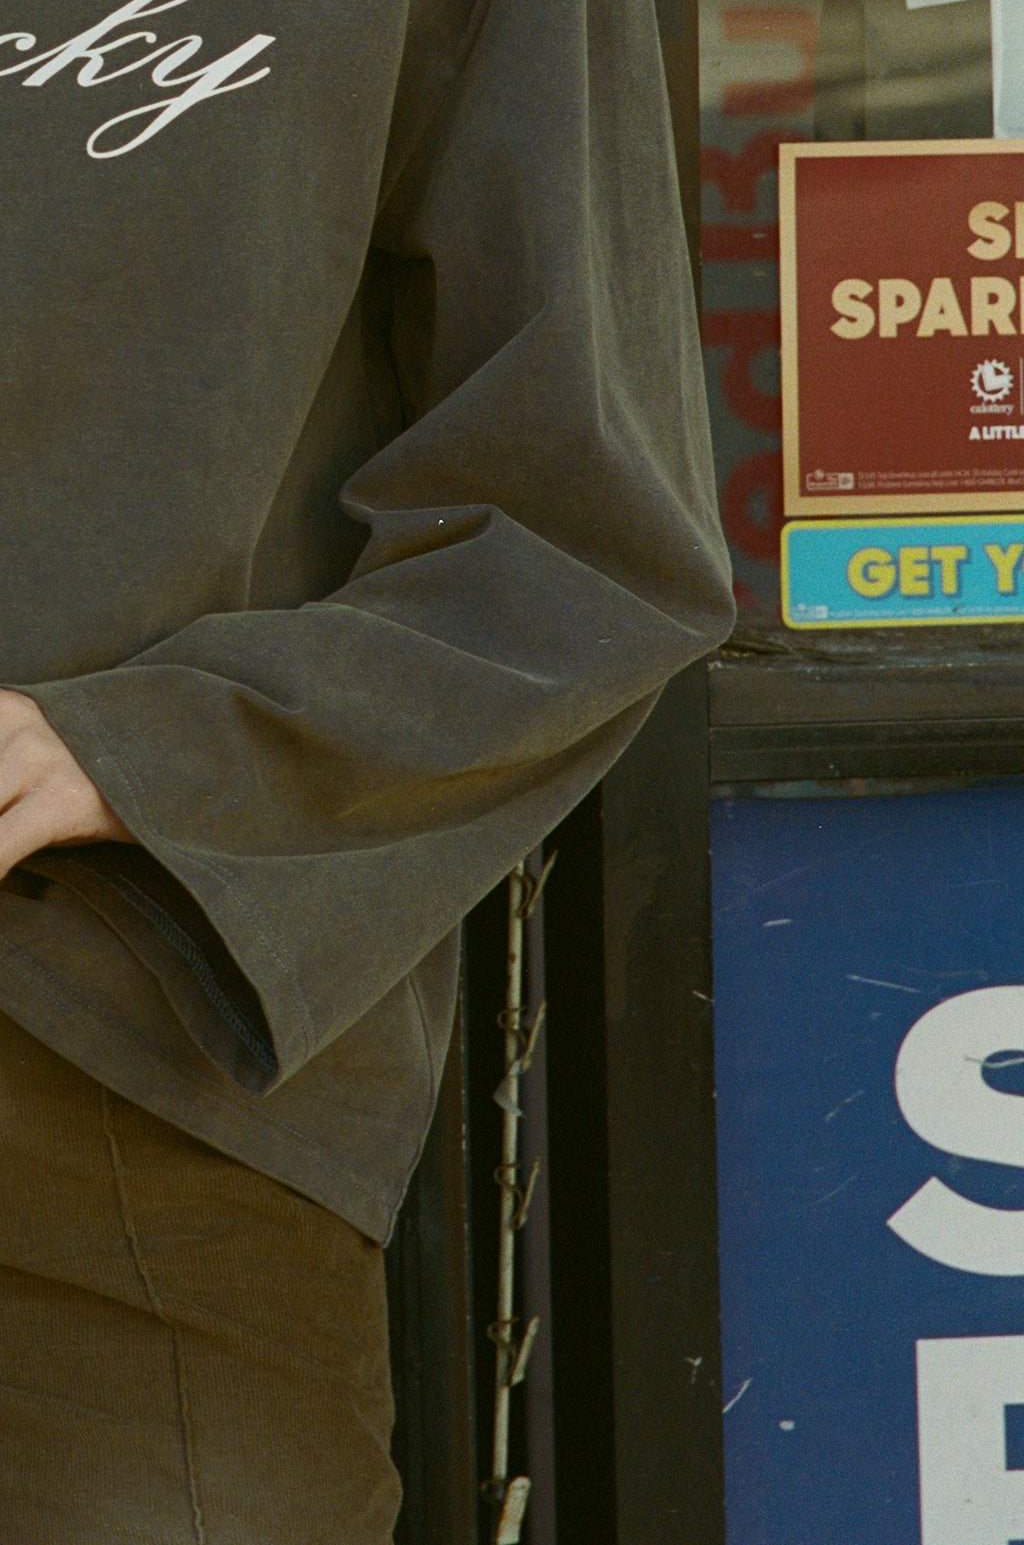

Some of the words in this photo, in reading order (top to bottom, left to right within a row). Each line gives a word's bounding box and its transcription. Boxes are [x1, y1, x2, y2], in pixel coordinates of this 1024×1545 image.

[967, 201, 1024, 260] S
[830, 276, 1024, 340] SPAR
[846, 546, 968, 597] GET
[983, 543, 1024, 593] Y
